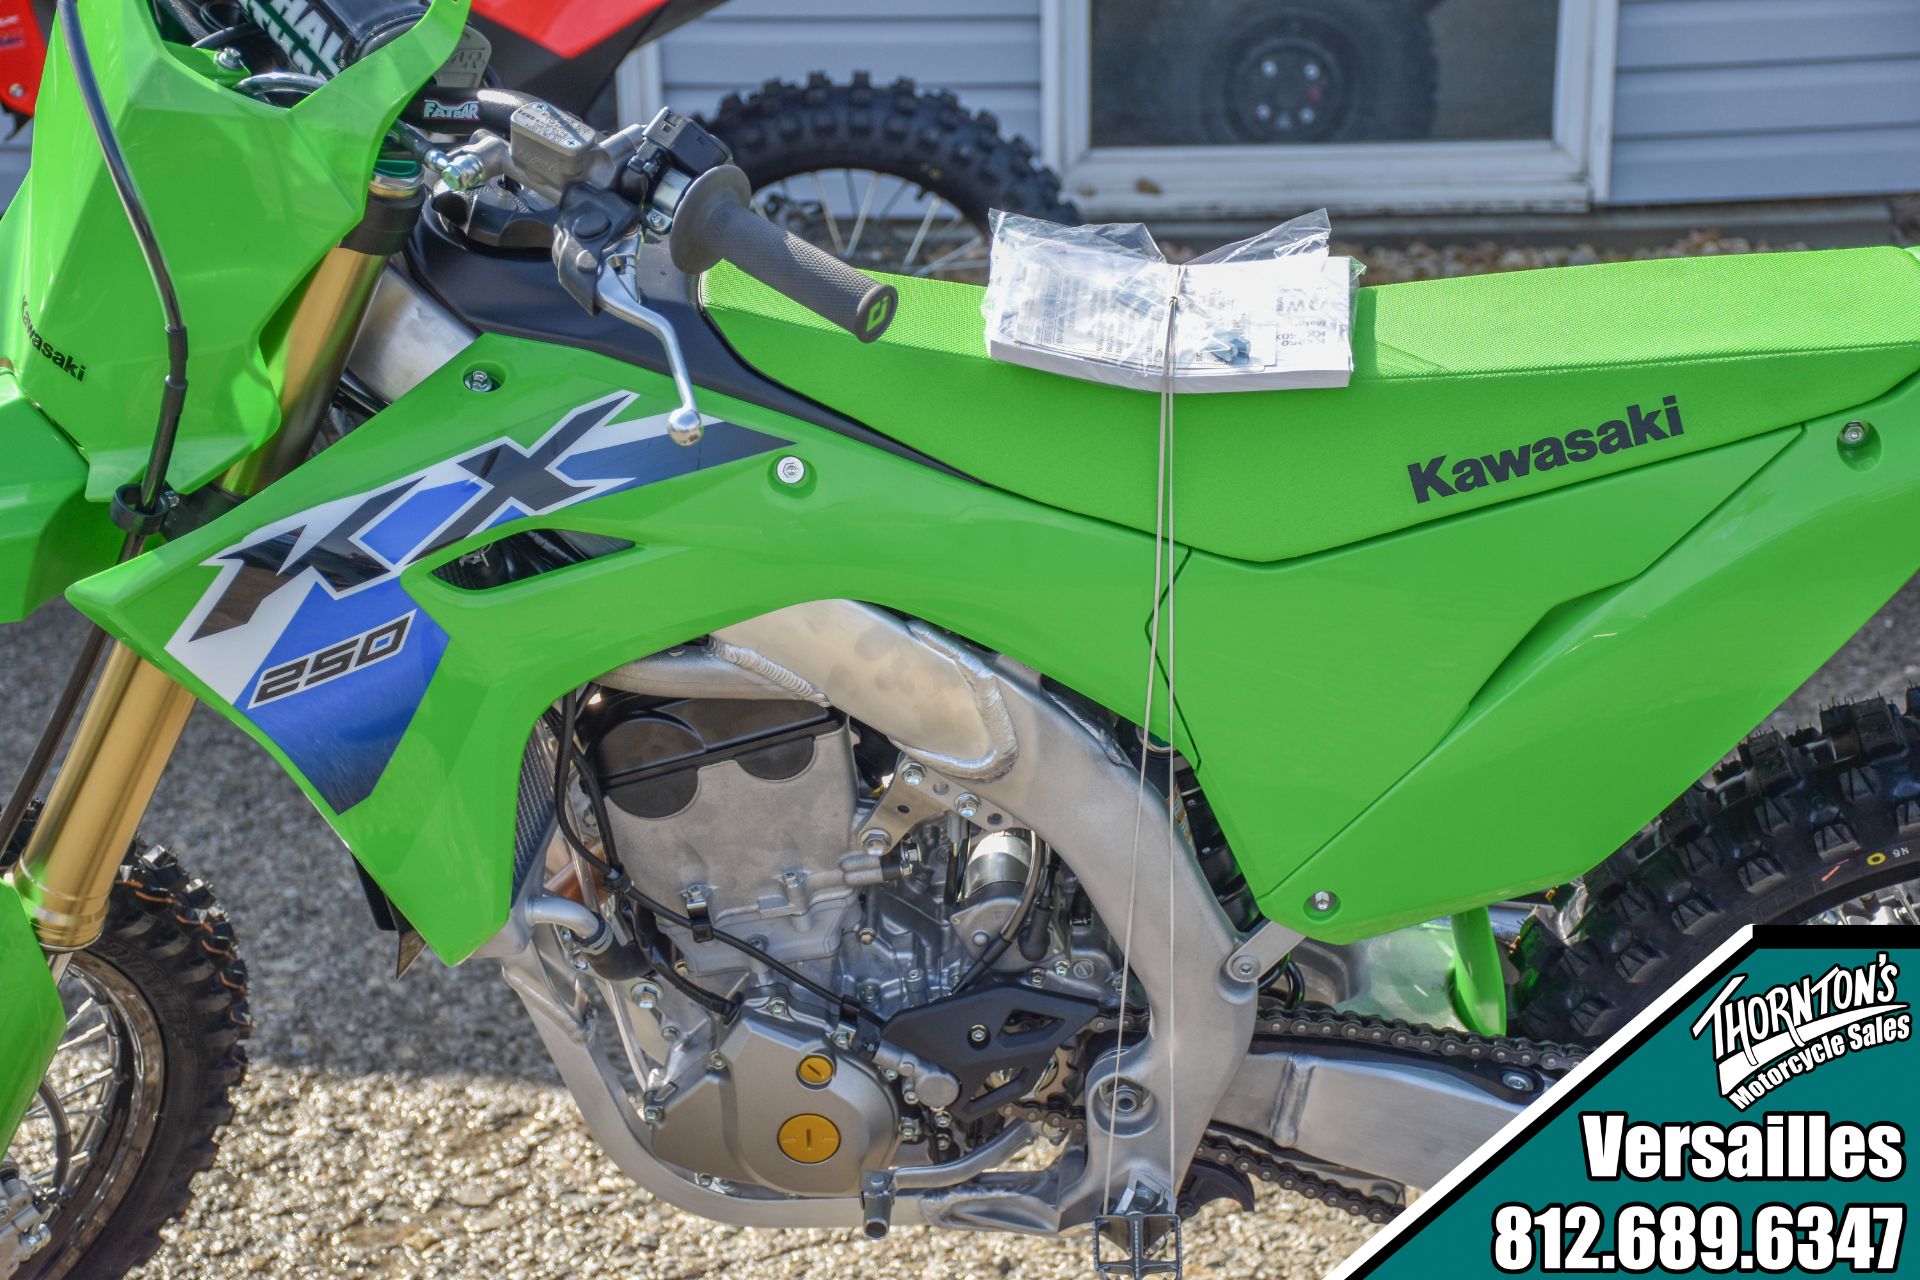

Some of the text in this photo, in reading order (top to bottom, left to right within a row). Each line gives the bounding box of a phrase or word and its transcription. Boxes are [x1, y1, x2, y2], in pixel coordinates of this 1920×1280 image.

[21, 295, 86, 382] Kawasaki
[1407, 395, 1684, 504] Kawasaki
[187, 391, 633, 643] KX
[251, 611, 413, 706] 250
